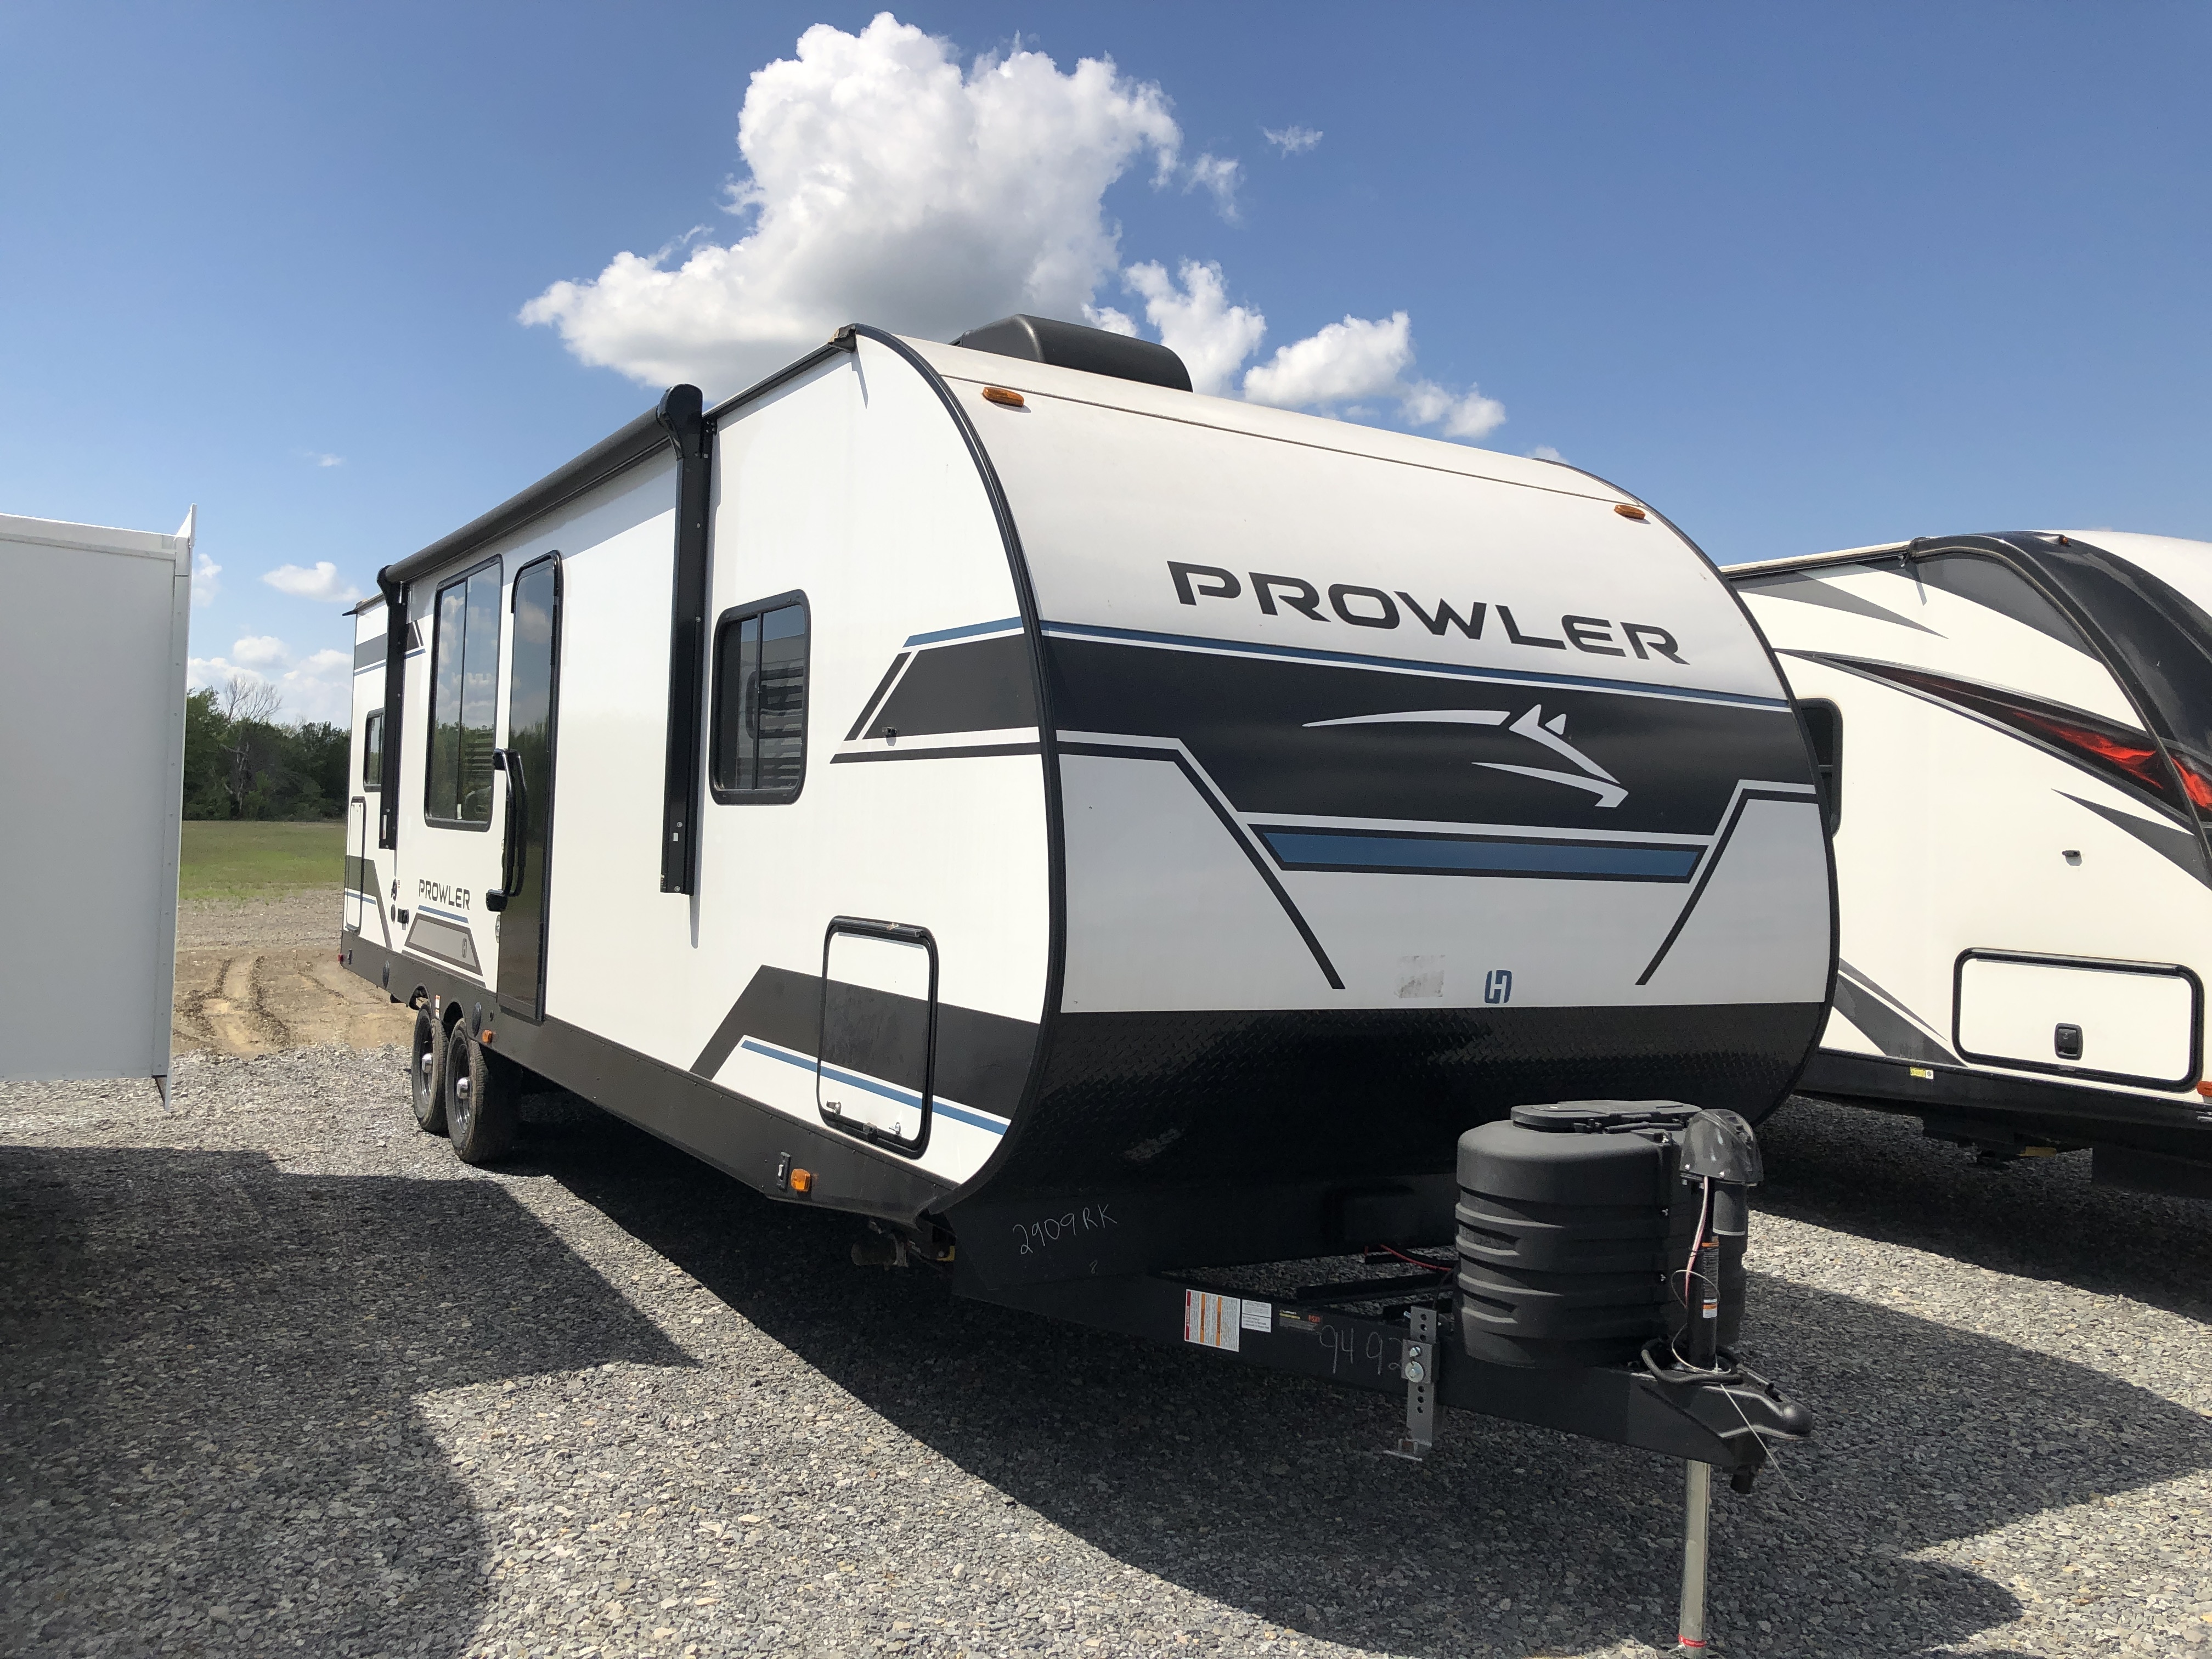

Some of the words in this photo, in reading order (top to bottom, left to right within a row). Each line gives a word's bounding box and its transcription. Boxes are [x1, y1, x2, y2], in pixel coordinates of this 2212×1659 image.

[1167, 561, 1690, 665] PROWLER
[419, 878, 470, 911] PROWLER
[1013, 1203, 1118, 1255] 2909RK
